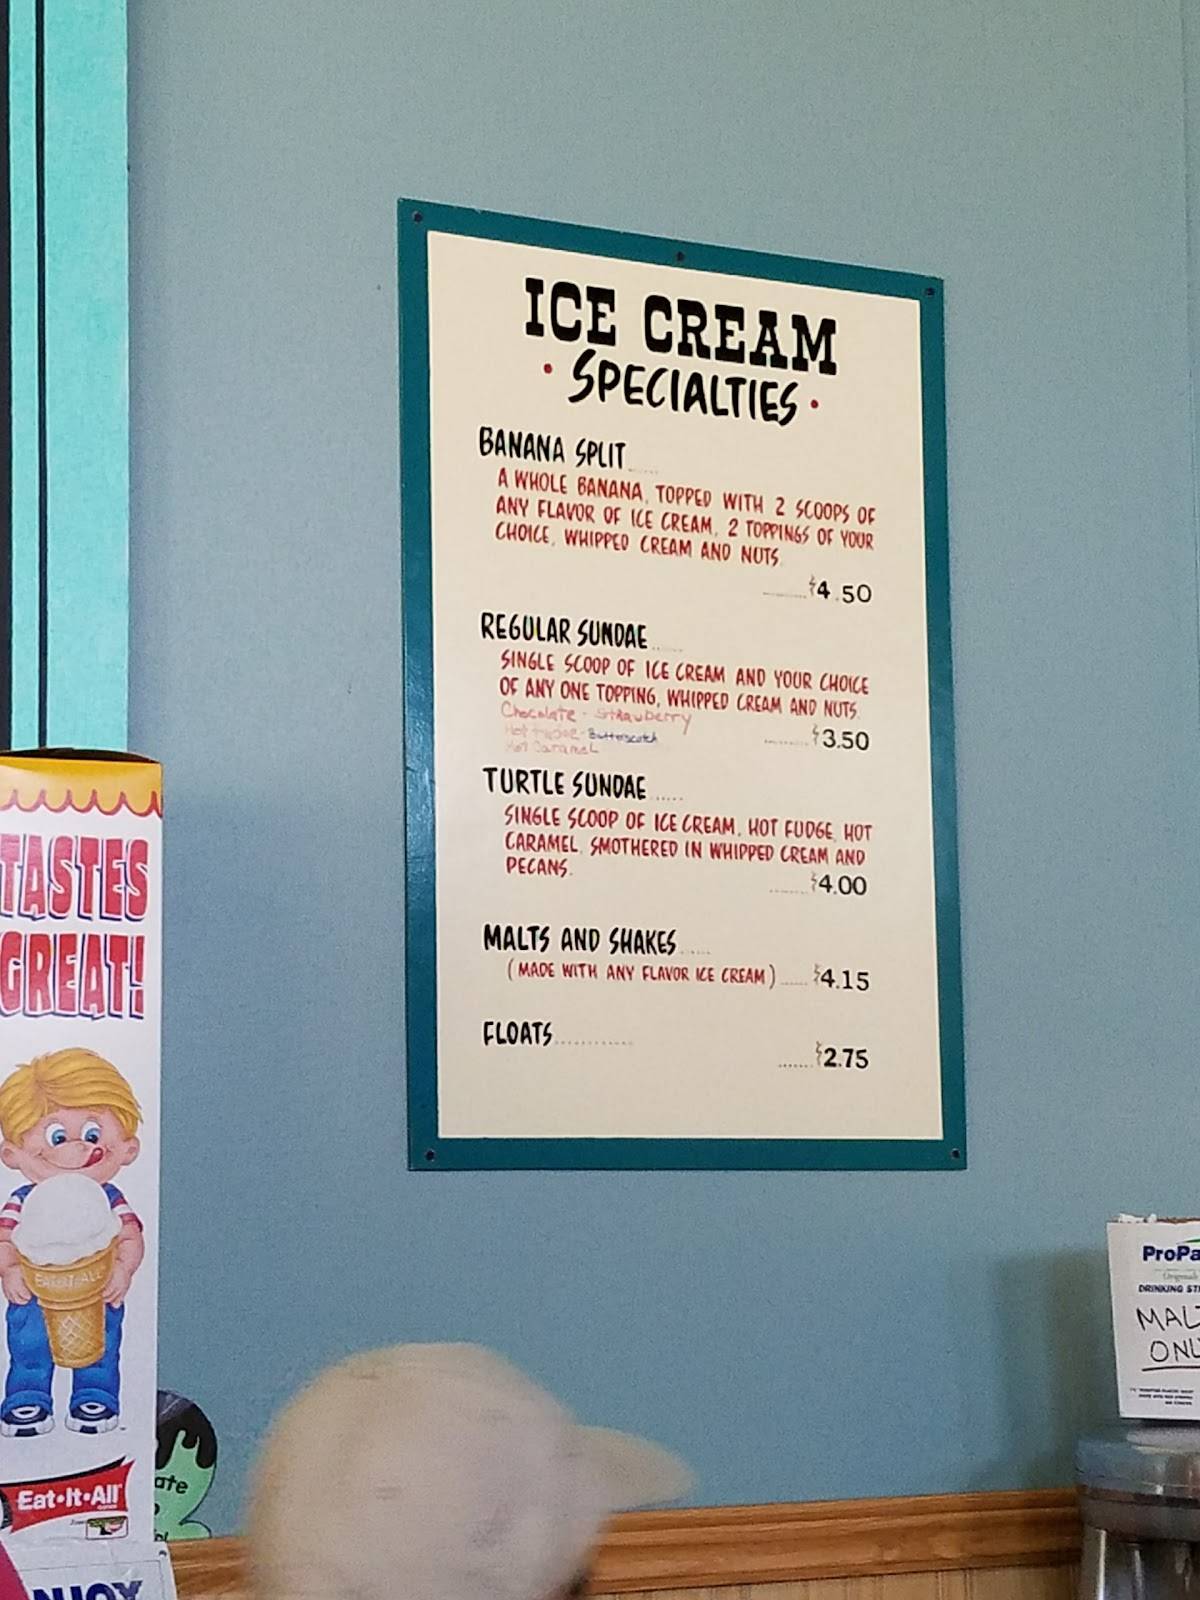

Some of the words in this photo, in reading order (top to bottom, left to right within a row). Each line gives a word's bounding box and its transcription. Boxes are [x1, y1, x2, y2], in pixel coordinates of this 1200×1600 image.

[525, 277, 616, 346] ICE
[644, 294, 837, 375] CREAM
[568, 348, 799, 426] SPECIALTIES
[479, 426, 565, 462] BANANA
[575, 438, 626, 469] SPLIT
[498, 467, 508, 488] A
[515, 469, 568, 494] WHOLE
[655, 485, 711, 508] TOPPED
[723, 492, 764, 514] WITH
[776, 497, 785, 516] 2
[796, 499, 850, 524] SCOOPS
[857, 507, 876, 525] OF
[496, 495, 529, 517] ANY
[537, 499, 595, 524] FLAVOR
[603, 506, 621, 525] OF
[631, 508, 653, 529] ICE
[728, 518, 738, 537] 2
[746, 519, 810, 545] TOPPINGS
[817, 528, 834, 545] OF
[840, 529, 874, 550] YOUR
[564, 529, 629, 551] WHIPPED
[640, 535, 692, 558] CREAM
[701, 541, 731, 562] AND
[481, 612, 570, 645] REGULAR
[577, 619, 648, 649] SUNDAE
[501, 649, 554, 671] SINGLE
[564, 653, 611, 675] SCOOP
[617, 658, 635, 677] OF
[646, 660, 669, 680] ICE
[676, 662, 725, 684] CREAM
[736, 667, 766, 688] AND
[774, 670, 812, 690] YOUR
[819, 672, 869, 695] CHOICE
[499, 676, 519, 696] OF
[525, 677, 555, 699] ANY
[560, 680, 590, 701] ONE
[596, 683, 661, 708] TOPPING,
[667, 688, 729, 711] WHIPPED
[737, 693, 782, 714] CREAM
[790, 698, 817, 716] AND
[812, 723, 870, 751] $3.50
[482, 767, 564, 795] TURTLE
[572, 771, 646, 800] SUNDAE
[504, 804, 560, 826] SINGLE
[568, 807, 619, 829] SCOOP
[625, 811, 646, 830] OF
[654, 812, 677, 833] ICE
[749, 818, 778, 837] HOT
[844, 823, 872, 843] HOT
[590, 836, 678, 857] SMOTHERED
[685, 840, 702, 859] IN
[710, 842, 774, 862] WHIPPED
[780, 845, 828, 865] CREAM
[836, 849, 865, 866] AND
[0, 833, 148, 920] TASTES
[811, 872, 867, 896] $4.00
[484, 923, 550, 952] MALTS
[561, 927, 600, 952] AND
[609, 927, 677, 955] SHAKES
[0, 930, 145, 1020] GREAT!
[562, 962, 598, 979] WITH
[607, 964, 635, 981] ANY
[642, 965, 689, 982] FLAVOR
[696, 966, 714, 982] ICE
[813, 963, 870, 991] $4.15
[483, 1021, 552, 1046] FLOATS
[816, 1040, 869, 1069] $2.75
[1138, 1284, 1183, 1293] DRINKING
[1186, 1284, 1200, 1293] ST
[1150, 1338, 1200, 1363] ONL
